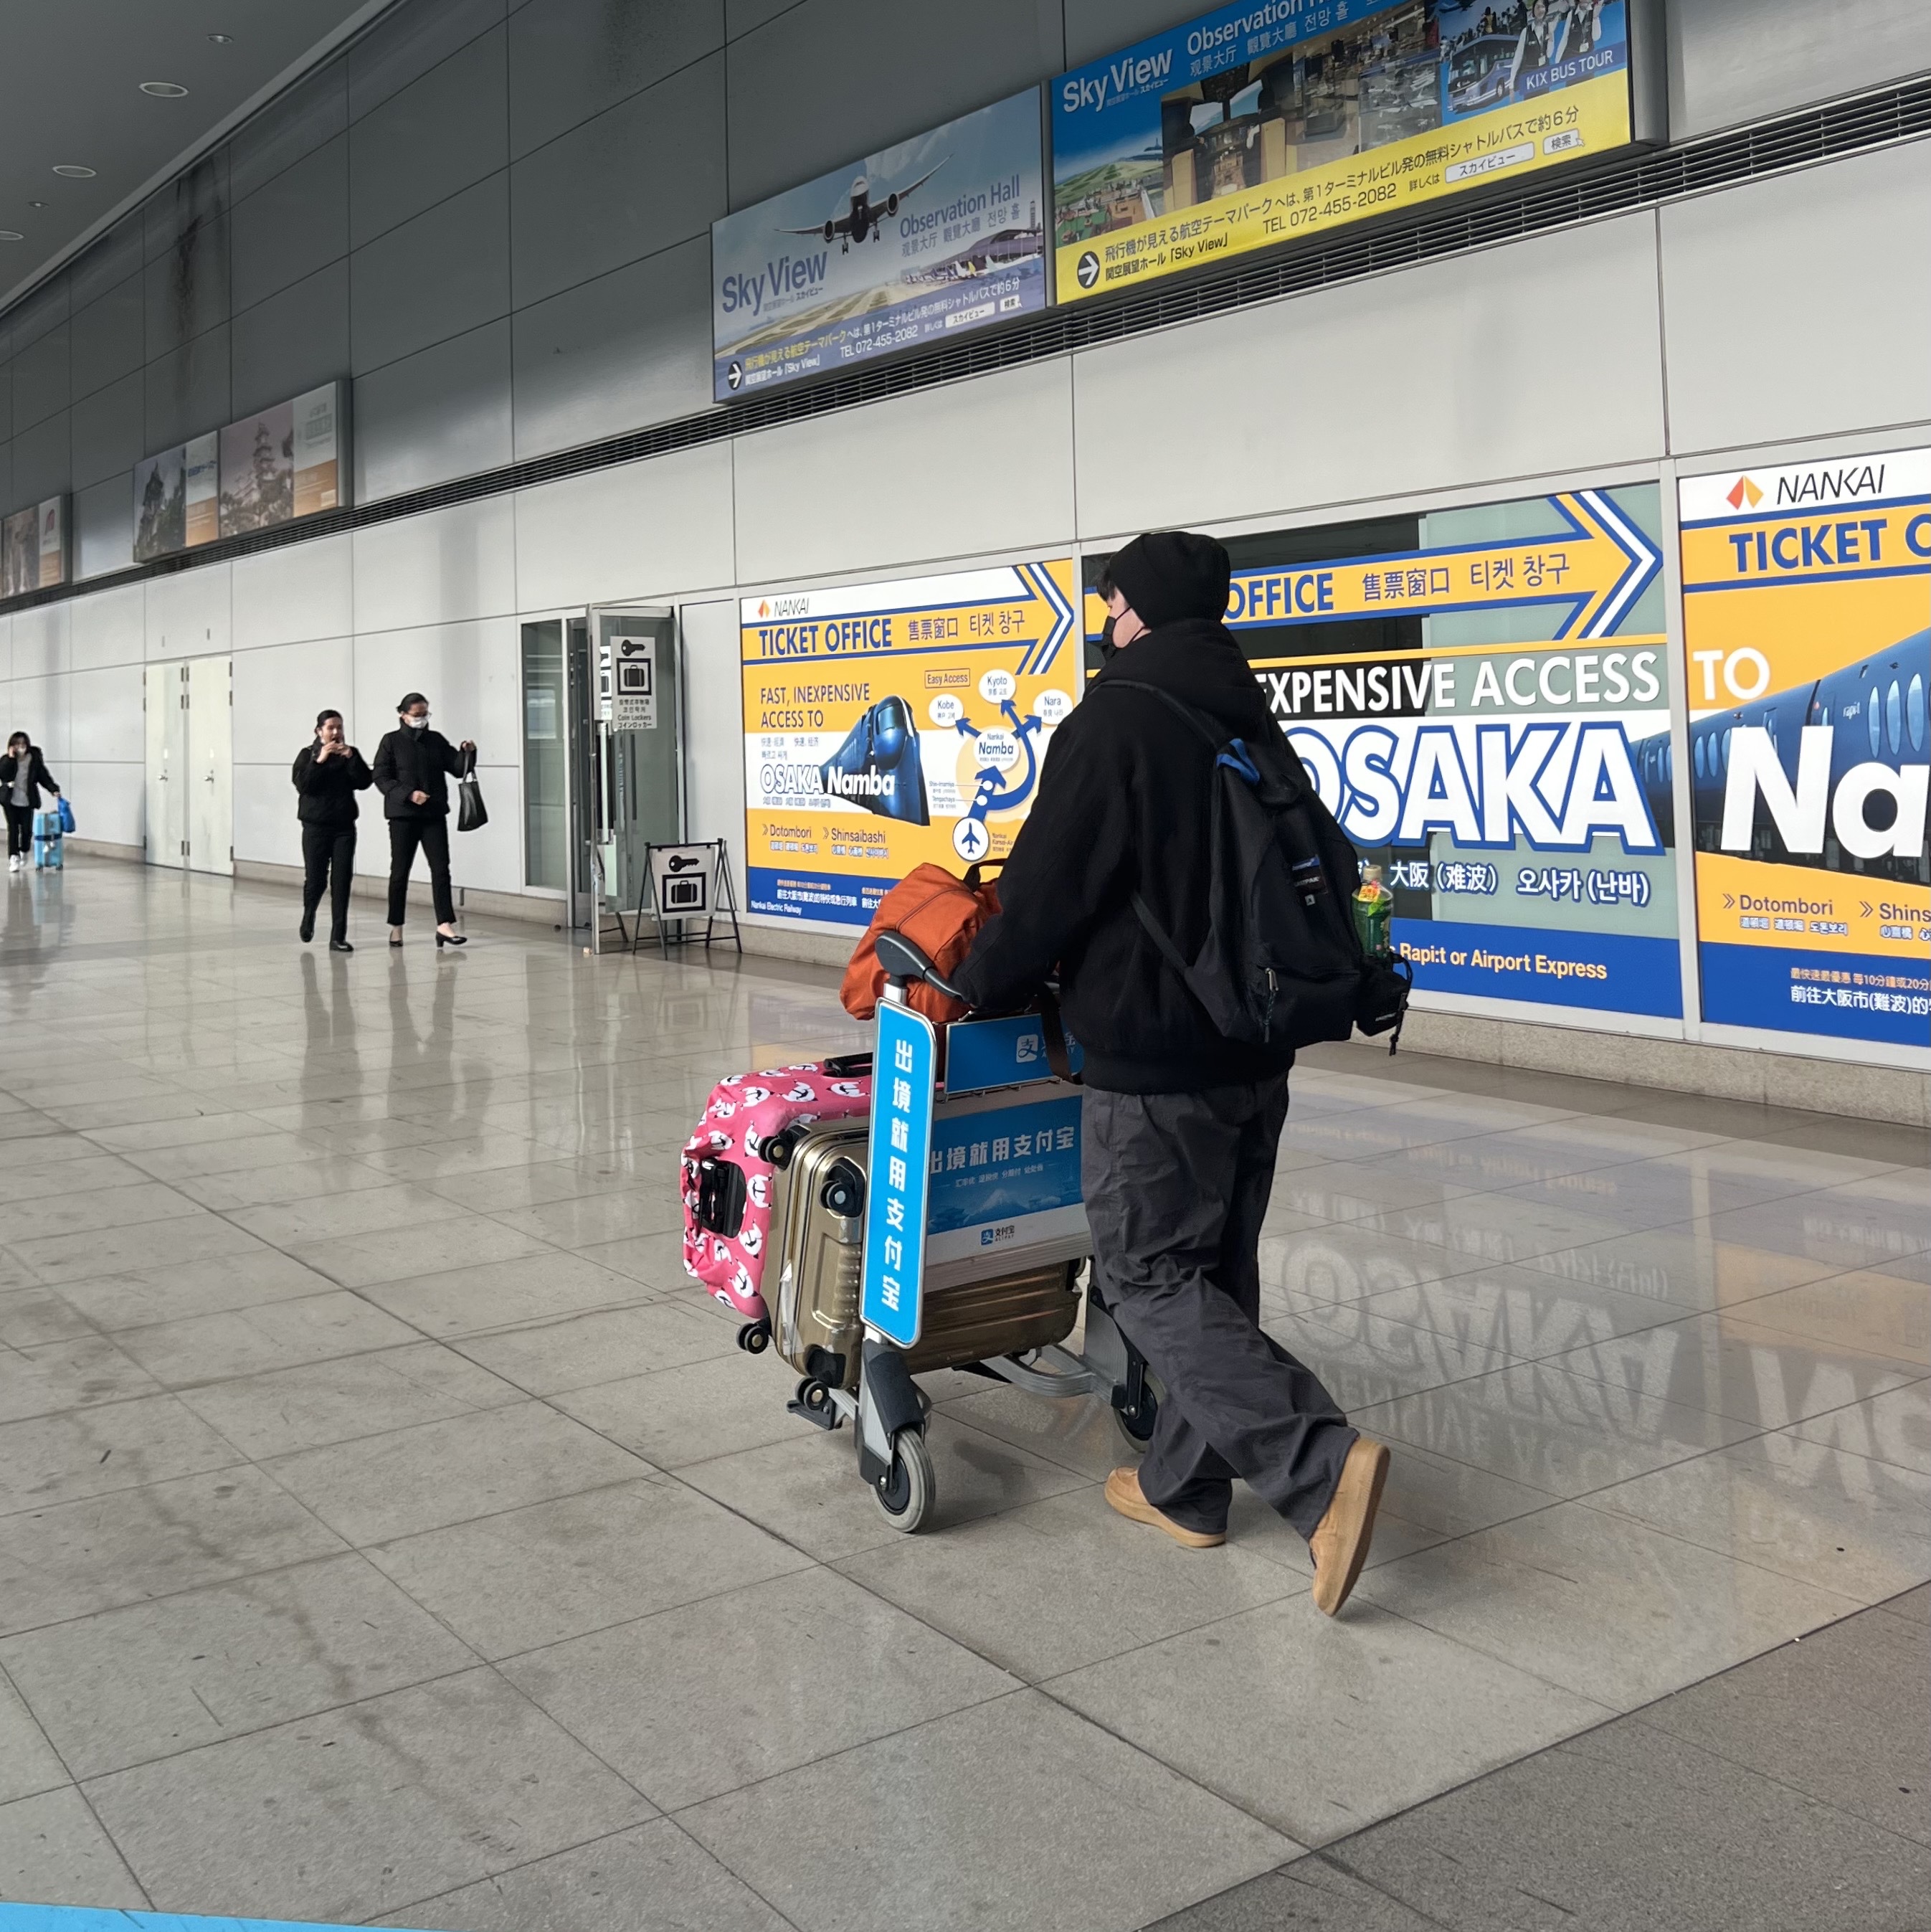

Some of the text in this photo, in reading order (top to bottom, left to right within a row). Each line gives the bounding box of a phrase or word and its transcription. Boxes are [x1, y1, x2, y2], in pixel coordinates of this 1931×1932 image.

[1063, 75, 1109, 113] Sky
[1110, 49, 1173, 93] View
[1527, 50, 1613, 90] KIX BUS TOUR
[1459, 153, 1516, 176] スカイビュー
[1551, 134, 1572, 150] 検索
[900, 174, 1020, 239] Observation Hall
[1263, 183, 1397, 235] TEL 072-455-2082
[722, 252, 827, 316] Sky View
[840, 325, 918, 358] TEL 072-455-2082
[1777, 464, 1885, 505] NANKAI
[1729, 518, 1887, 573] TICKET
[1362, 567, 1449, 602] 售票窗口
[1471, 553, 1570, 591] 티켓 창구
[774, 597, 810, 618] NANKAI
[1224, 572, 1334, 620] OFFICE
[759, 618, 892, 656] TICKET OFFICE
[969, 610, 1025, 637] 티켓 창구
[927, 673, 968, 686] Easy Access
[987, 676, 1007, 687] Kyoto
[1471, 651, 1660, 707] ACCESS
[1693, 647, 1770, 701] TO
[760, 683, 870, 706] FAST, INEXPENSIVE
[937, 700, 954, 710] Kobe
[1044, 696, 1061, 706] Nara
[761, 709, 823, 729] ACCESS TO
[979, 742, 1014, 755] Namba
[760, 764, 896, 796] OSAKA Namba
[770, 824, 812, 838] Dotombori
[831, 828, 886, 843] Shinsaibashi
[1517, 867, 1651, 907] 오사카 (난바)
[1740, 895, 1833, 916] Dotombori
[1400, 942, 1608, 980] Rapi:t or Airport Express
[1853, 972, 1931, 991] 每10分鐘或20分
[1790, 985, 1931, 1015] 前往大阪市(難波)的
[930, 1126, 1074, 1175] 出境就用支付宝
[881, 1038, 914, 1313] 出境就用支付宝
